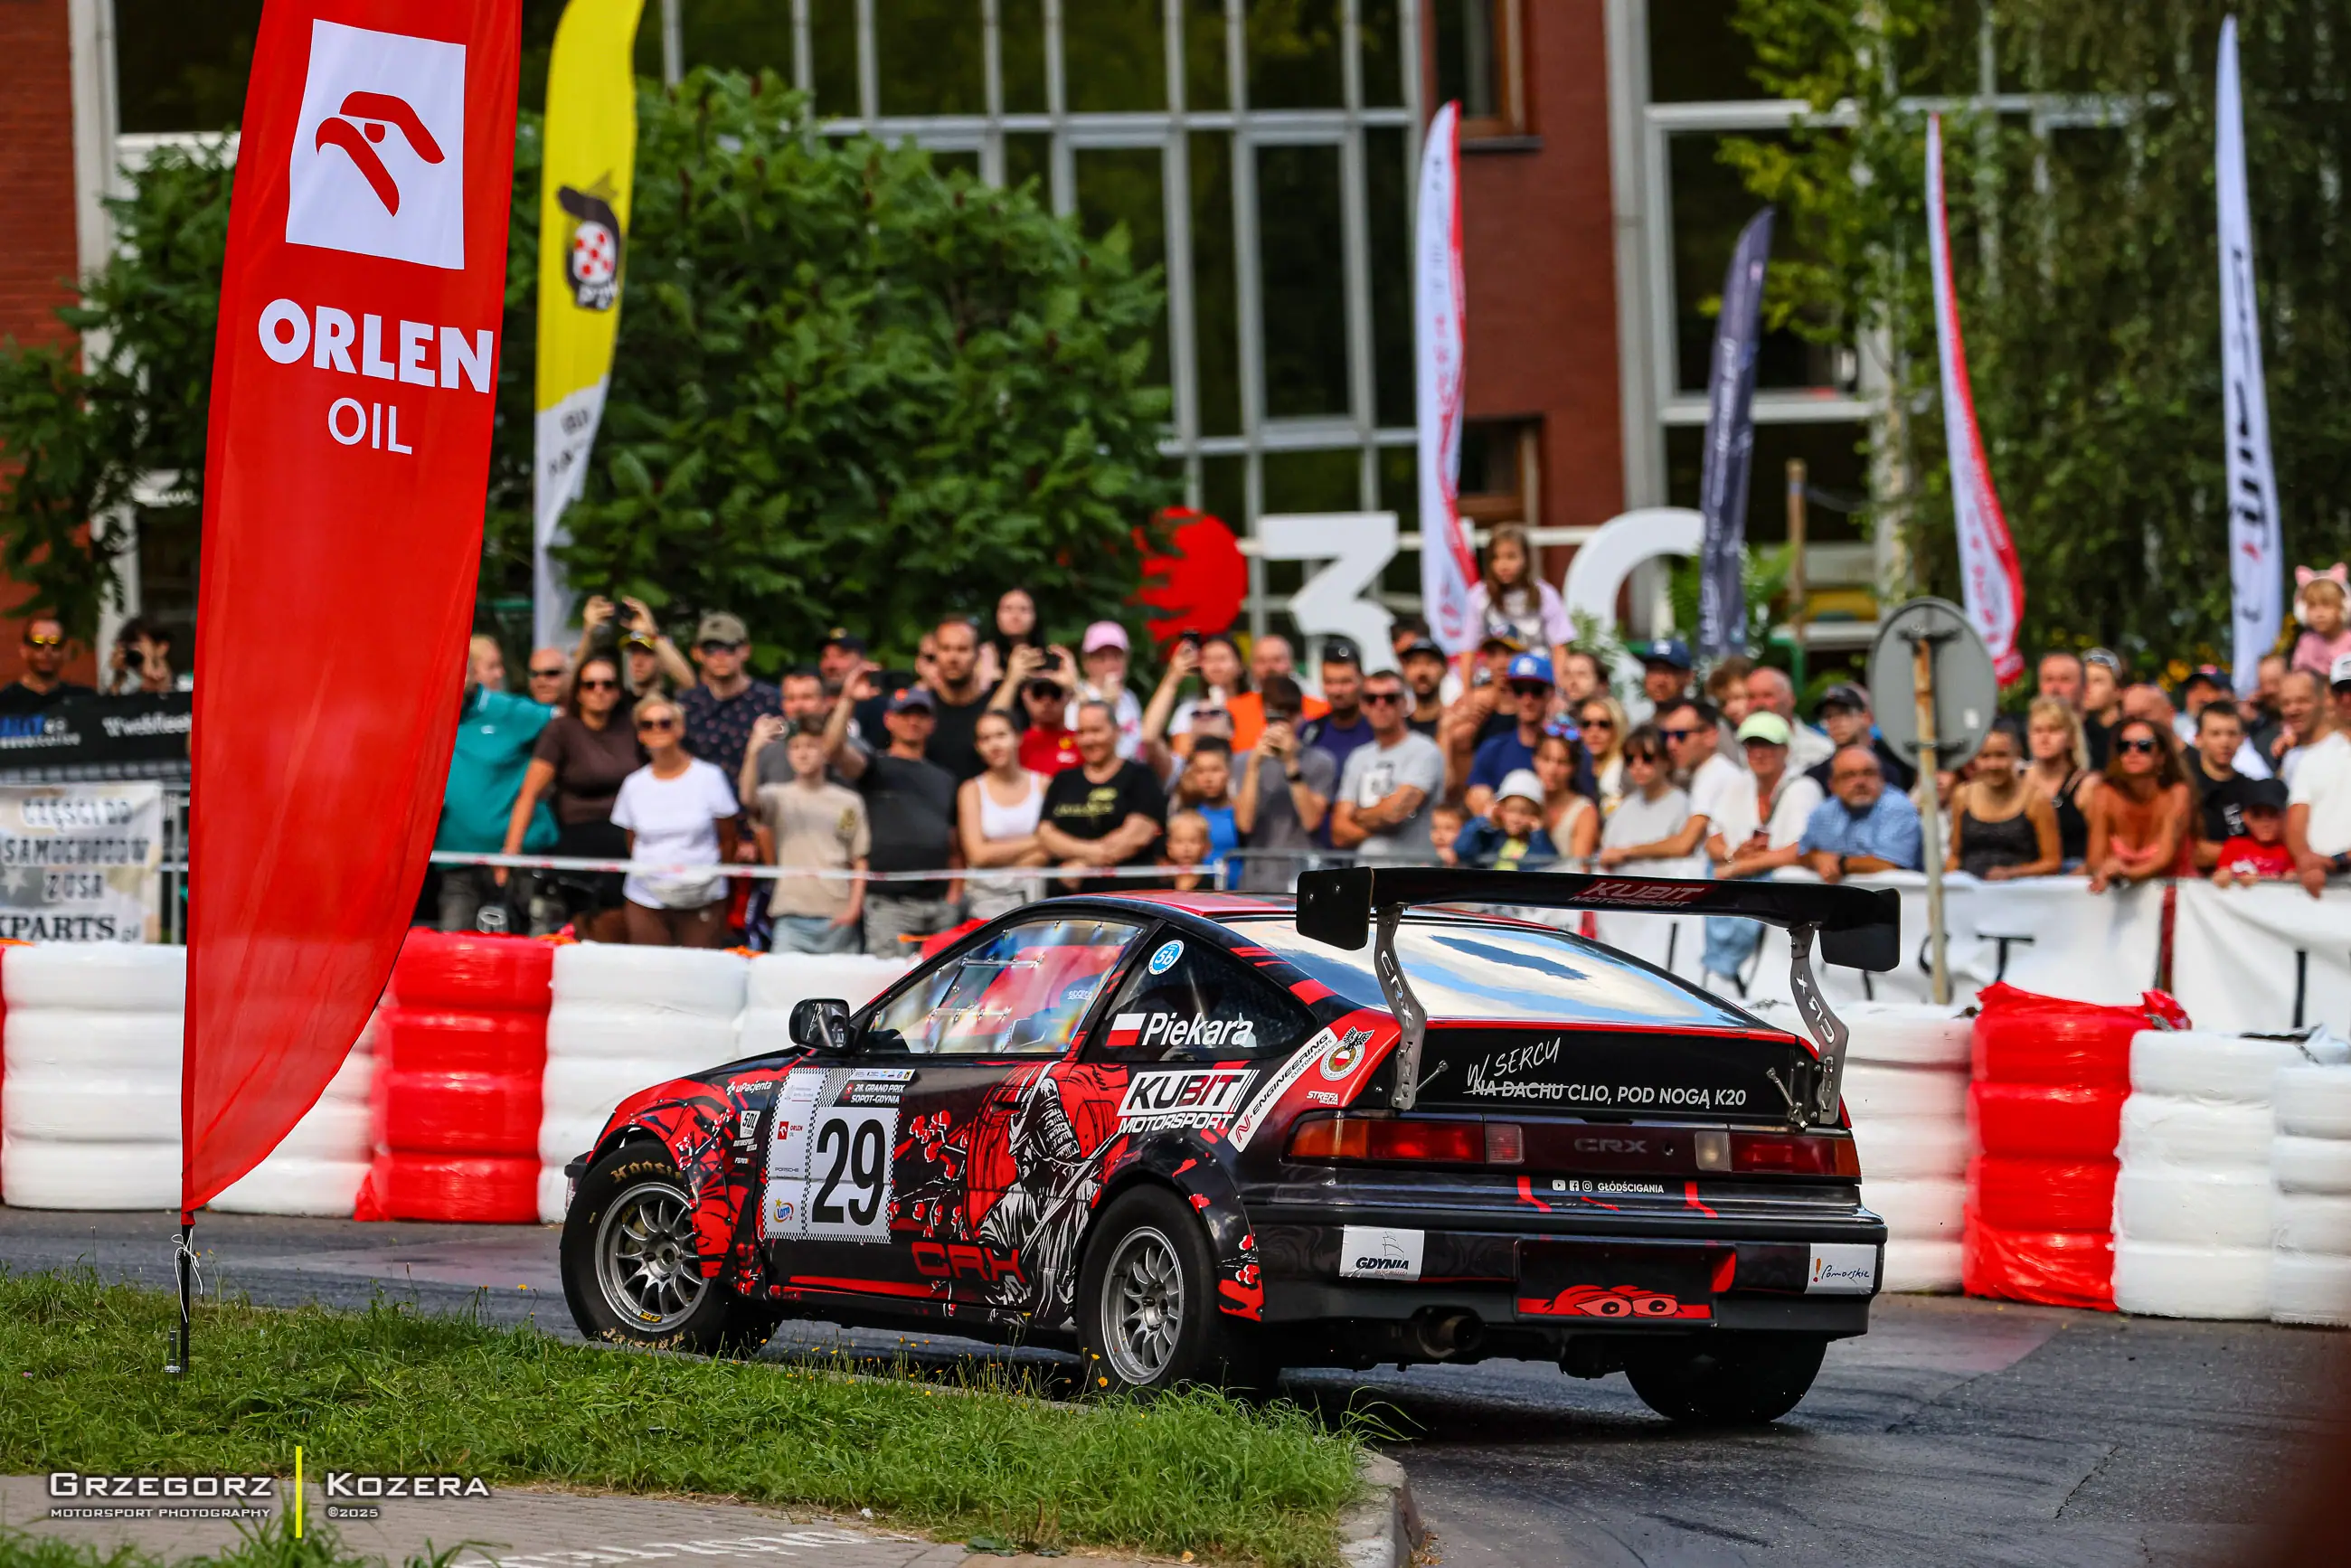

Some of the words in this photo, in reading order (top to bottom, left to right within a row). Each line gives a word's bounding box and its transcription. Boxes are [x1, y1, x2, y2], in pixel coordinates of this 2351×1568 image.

[259, 298, 494, 394] ORLEN
[327, 397, 412, 455] OIL
[1583, 882, 1705, 900] KUBIT
[1142, 1012, 1255, 1046] Piekara
[1290, 1054, 1314, 1079] CUSTOM
[1314, 1039, 1333, 1057] PARTS
[1493, 1037, 1562, 1078] SERCU
[735, 1081, 773, 1094] uPacjenta
[854, 1083, 864, 1092] 28.
[864, 1083, 887, 1093] GRAND
[888, 1084, 905, 1093] PRIX
[1127, 1073, 1243, 1110] KUBIT
[1306, 1090, 1339, 1100] STREFA
[1501, 1081, 1564, 1100] DACHU
[1567, 1084, 1612, 1105] CLIO,
[1617, 1086, 1656, 1104] POD
[1659, 1088, 1711, 1110] NOGĄ
[1714, 1088, 1747, 1106] K20
[850, 1094, 901, 1104] SOPOT-GDYNIA
[1118, 1112, 1235, 1134] MOTORSPORT
[1574, 1137, 1648, 1155] CRX
[812, 1118, 886, 1226] 29
[1597, 1179, 1665, 1194] GŁÓDŚCIGANIA
[1355, 1257, 1410, 1270] GDYNIA
[1820, 1264, 1870, 1280] Pomorskie
